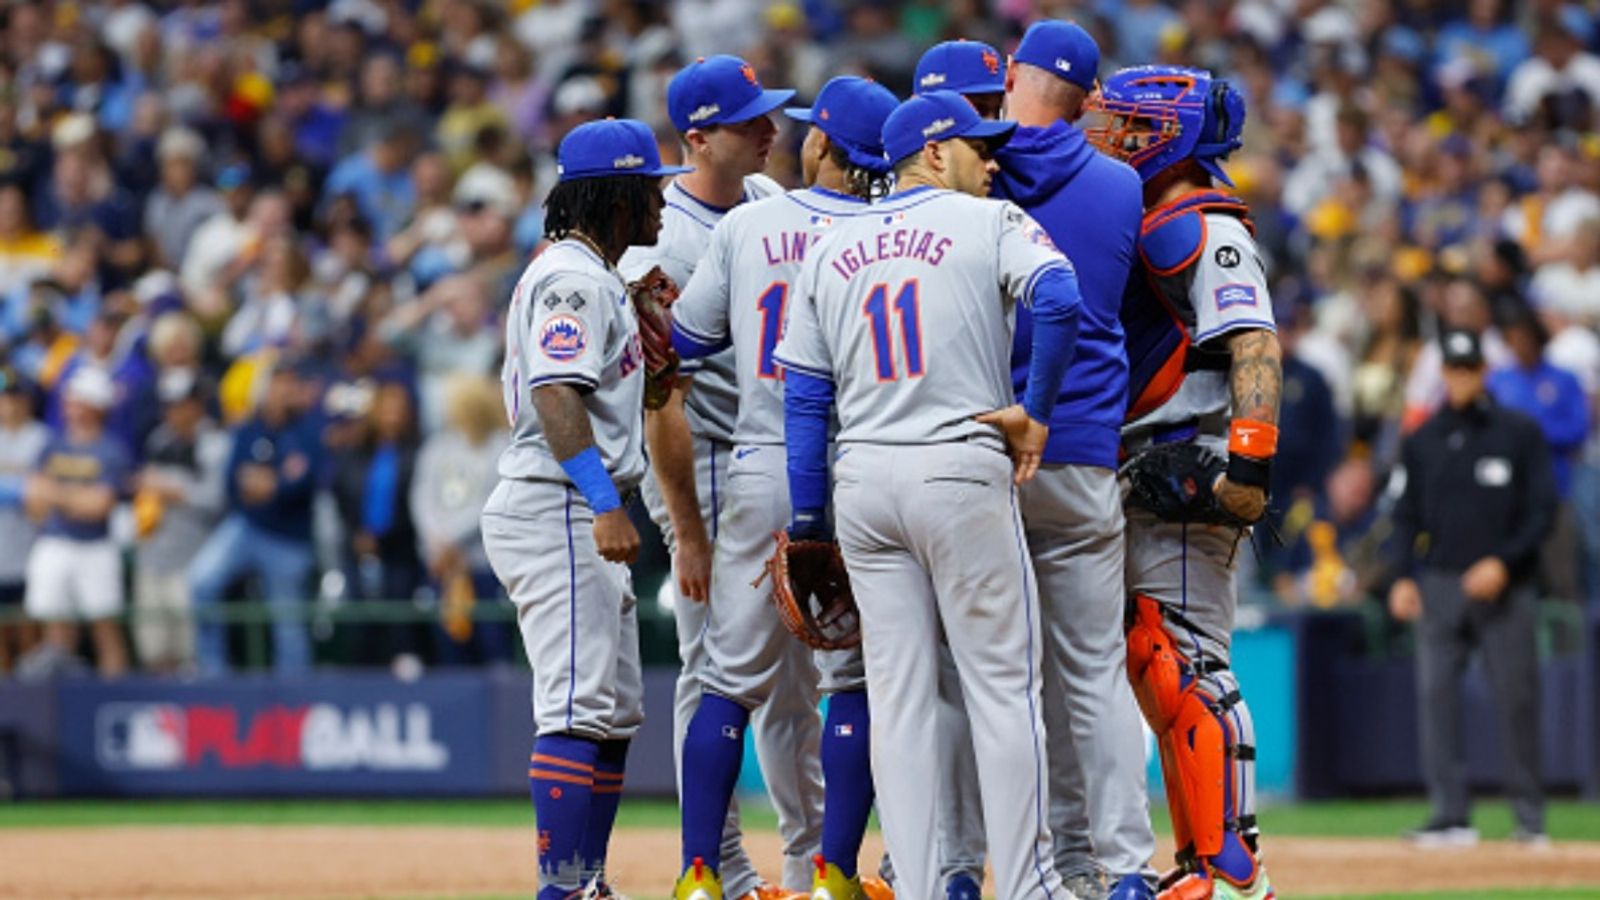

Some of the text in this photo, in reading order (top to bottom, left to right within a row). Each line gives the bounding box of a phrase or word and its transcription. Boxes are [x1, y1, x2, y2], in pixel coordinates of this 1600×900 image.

[762, 231, 821, 266] LIN
[831, 229, 953, 282] IGLESIAS
[1219, 250, 1238, 265] 24
[757, 280, 788, 381] 1
[862, 277, 927, 384] 11
